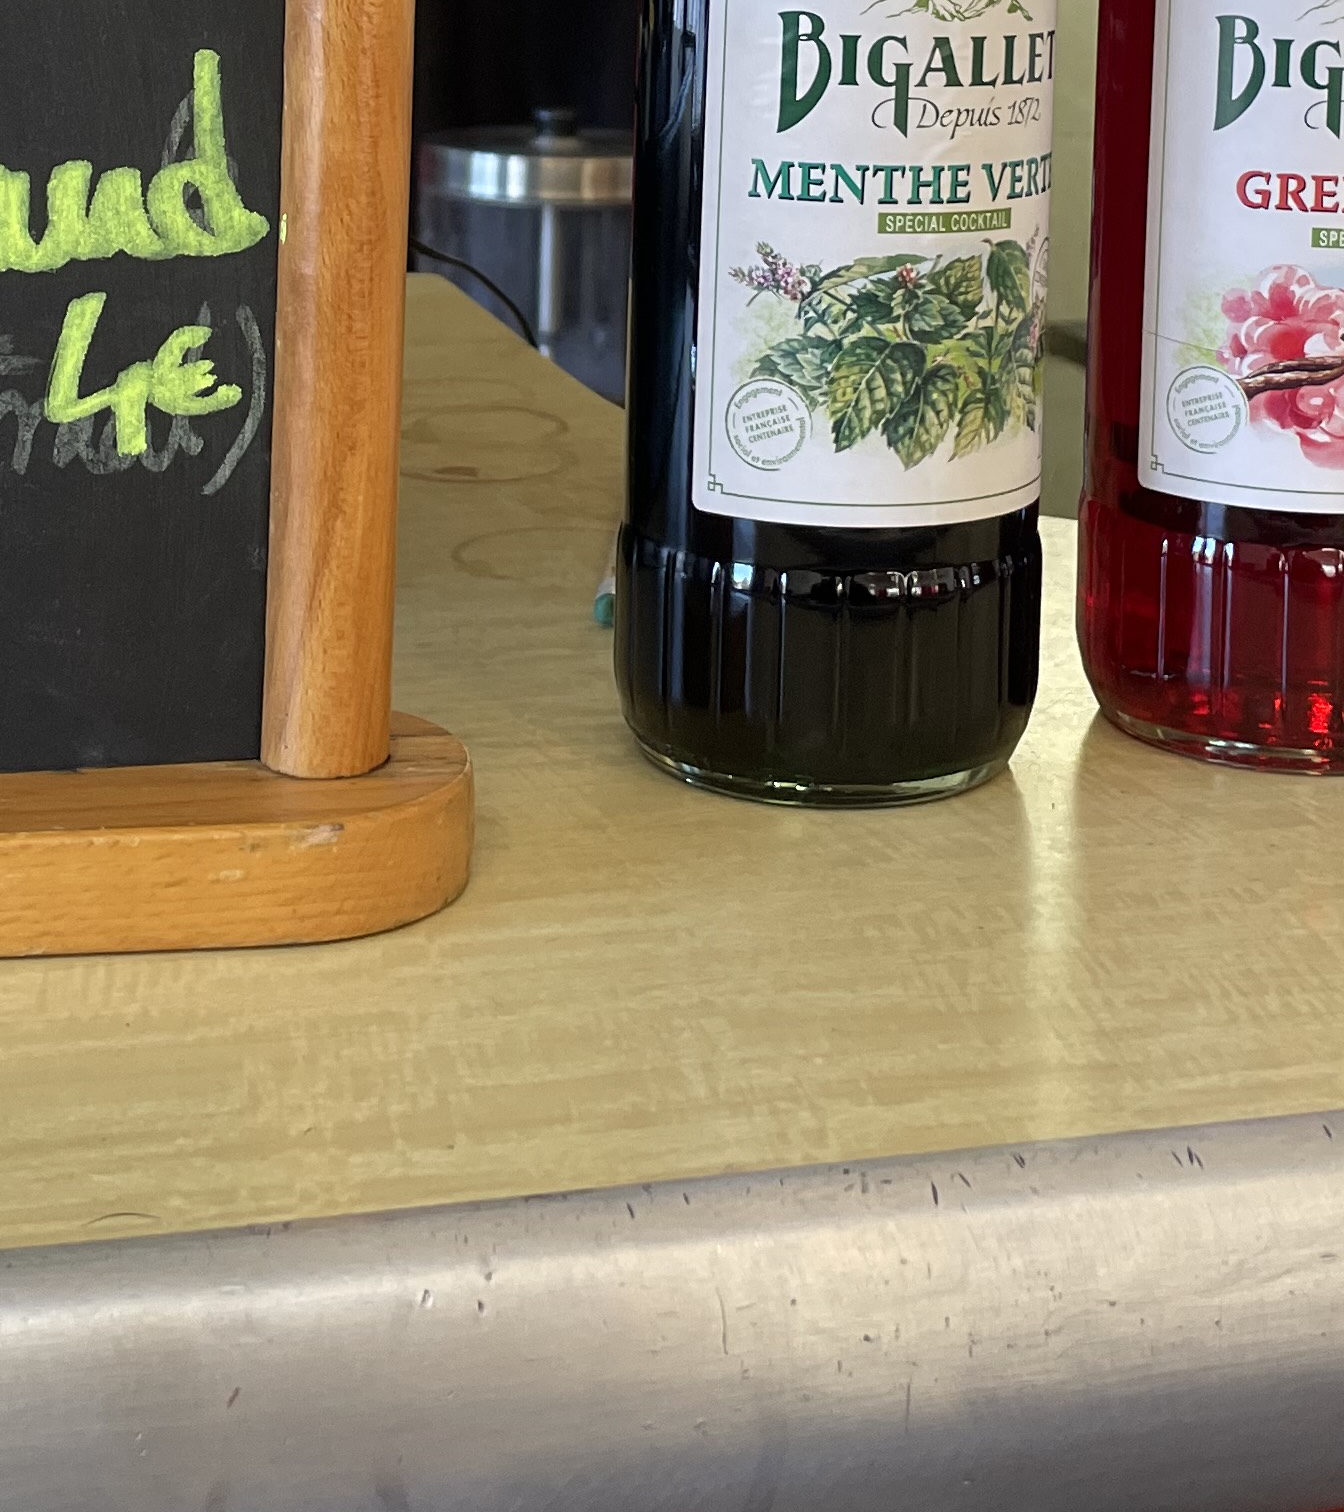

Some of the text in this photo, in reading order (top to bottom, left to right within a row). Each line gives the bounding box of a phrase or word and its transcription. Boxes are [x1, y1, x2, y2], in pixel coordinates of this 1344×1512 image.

[775, 10, 1055, 138] BIGALLET
[915, 96, 1042, 140] Depuis 1872
[748, 157, 972, 205] MENTHE
[885, 211, 1008, 233] SPÉCIAL COCKTAIL
[742, 404, 787, 424] ENTREPRISE
[748, 424, 794, 443] CENTENAIRE
